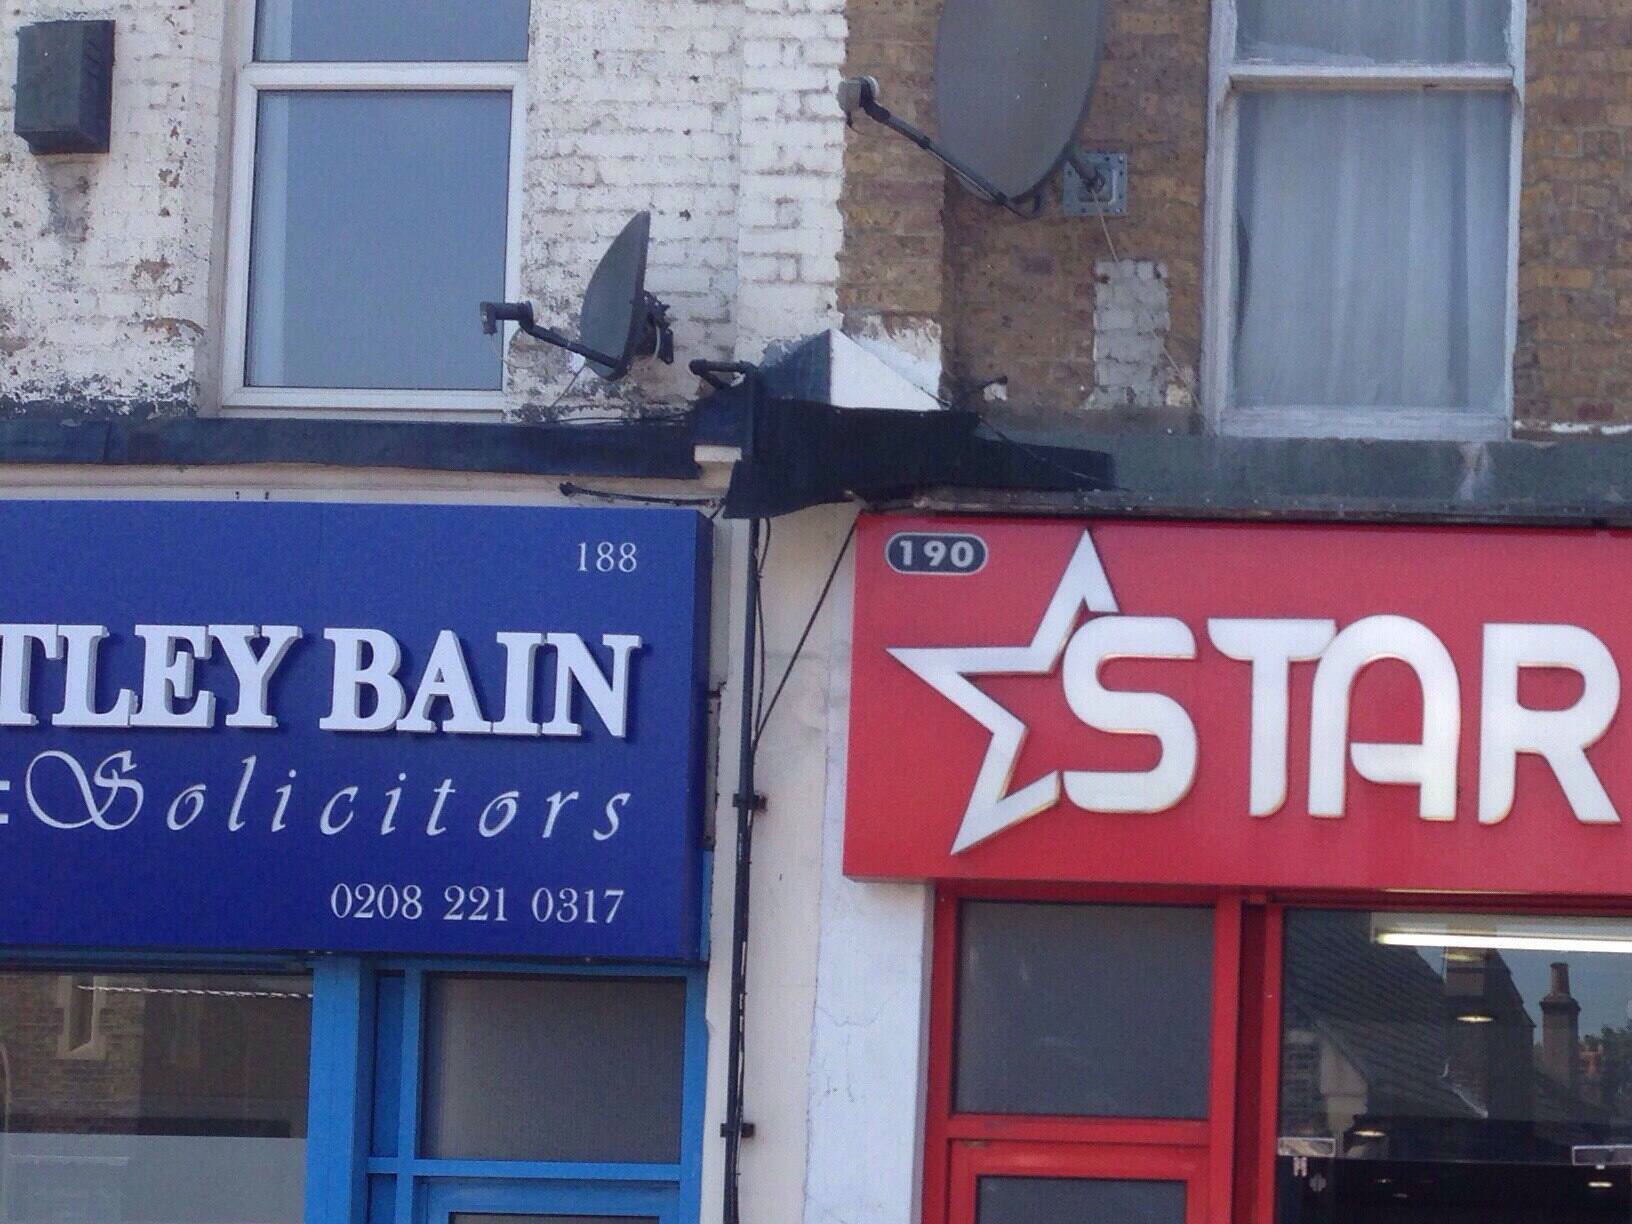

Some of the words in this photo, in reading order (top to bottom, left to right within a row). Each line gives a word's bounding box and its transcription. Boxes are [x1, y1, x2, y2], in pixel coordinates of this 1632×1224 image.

[576, 541, 639, 573] 188
[898, 540, 976, 569] 190
[319, 628, 643, 738] BAIN
[1061, 613, 1623, 826] STAR
[25, 750, 631, 841] Solicitors
[329, 882, 424, 921] 0208
[443, 886, 506, 921] 221
[531, 889, 625, 923] 0317
